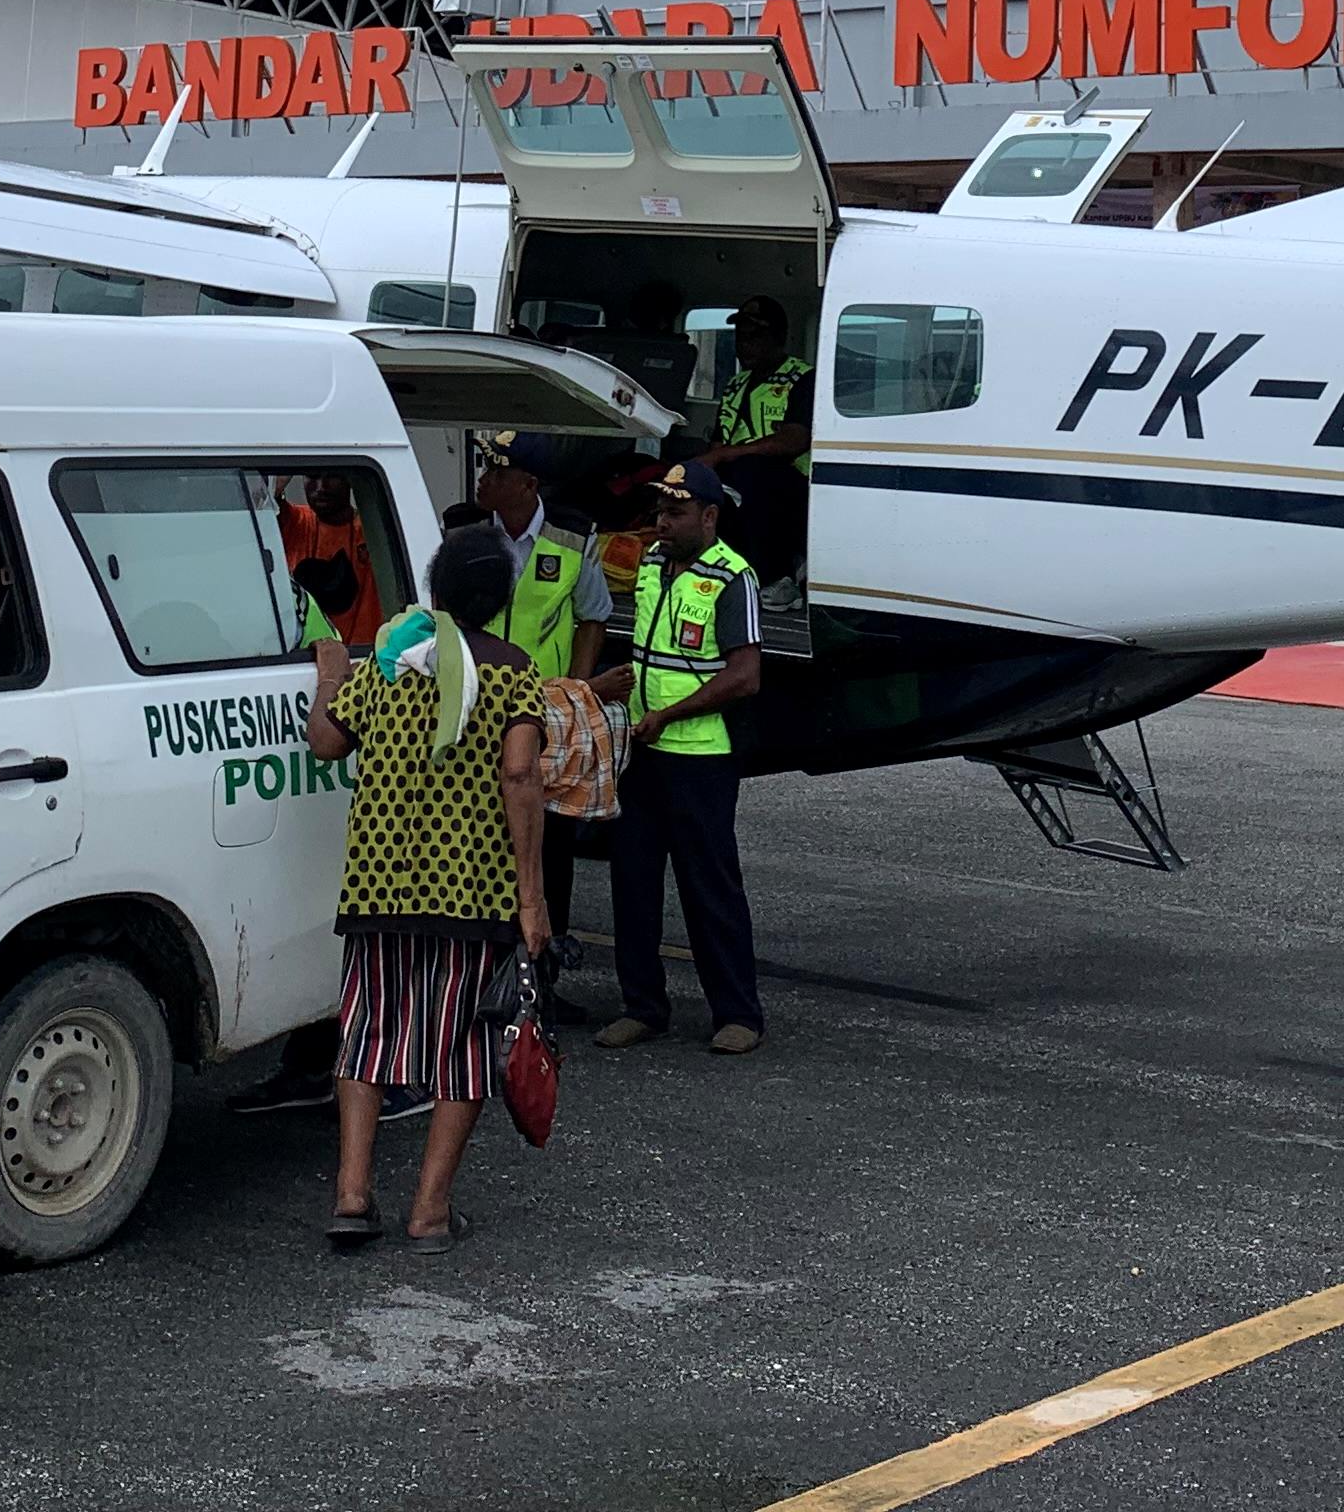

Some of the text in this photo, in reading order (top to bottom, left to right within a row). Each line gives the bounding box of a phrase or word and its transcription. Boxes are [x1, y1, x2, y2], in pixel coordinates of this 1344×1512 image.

[74, 26, 411, 128] BANDAR
[680, 603, 709, 621] DGCA
[144, 691, 309, 758] PUSKESMAS
